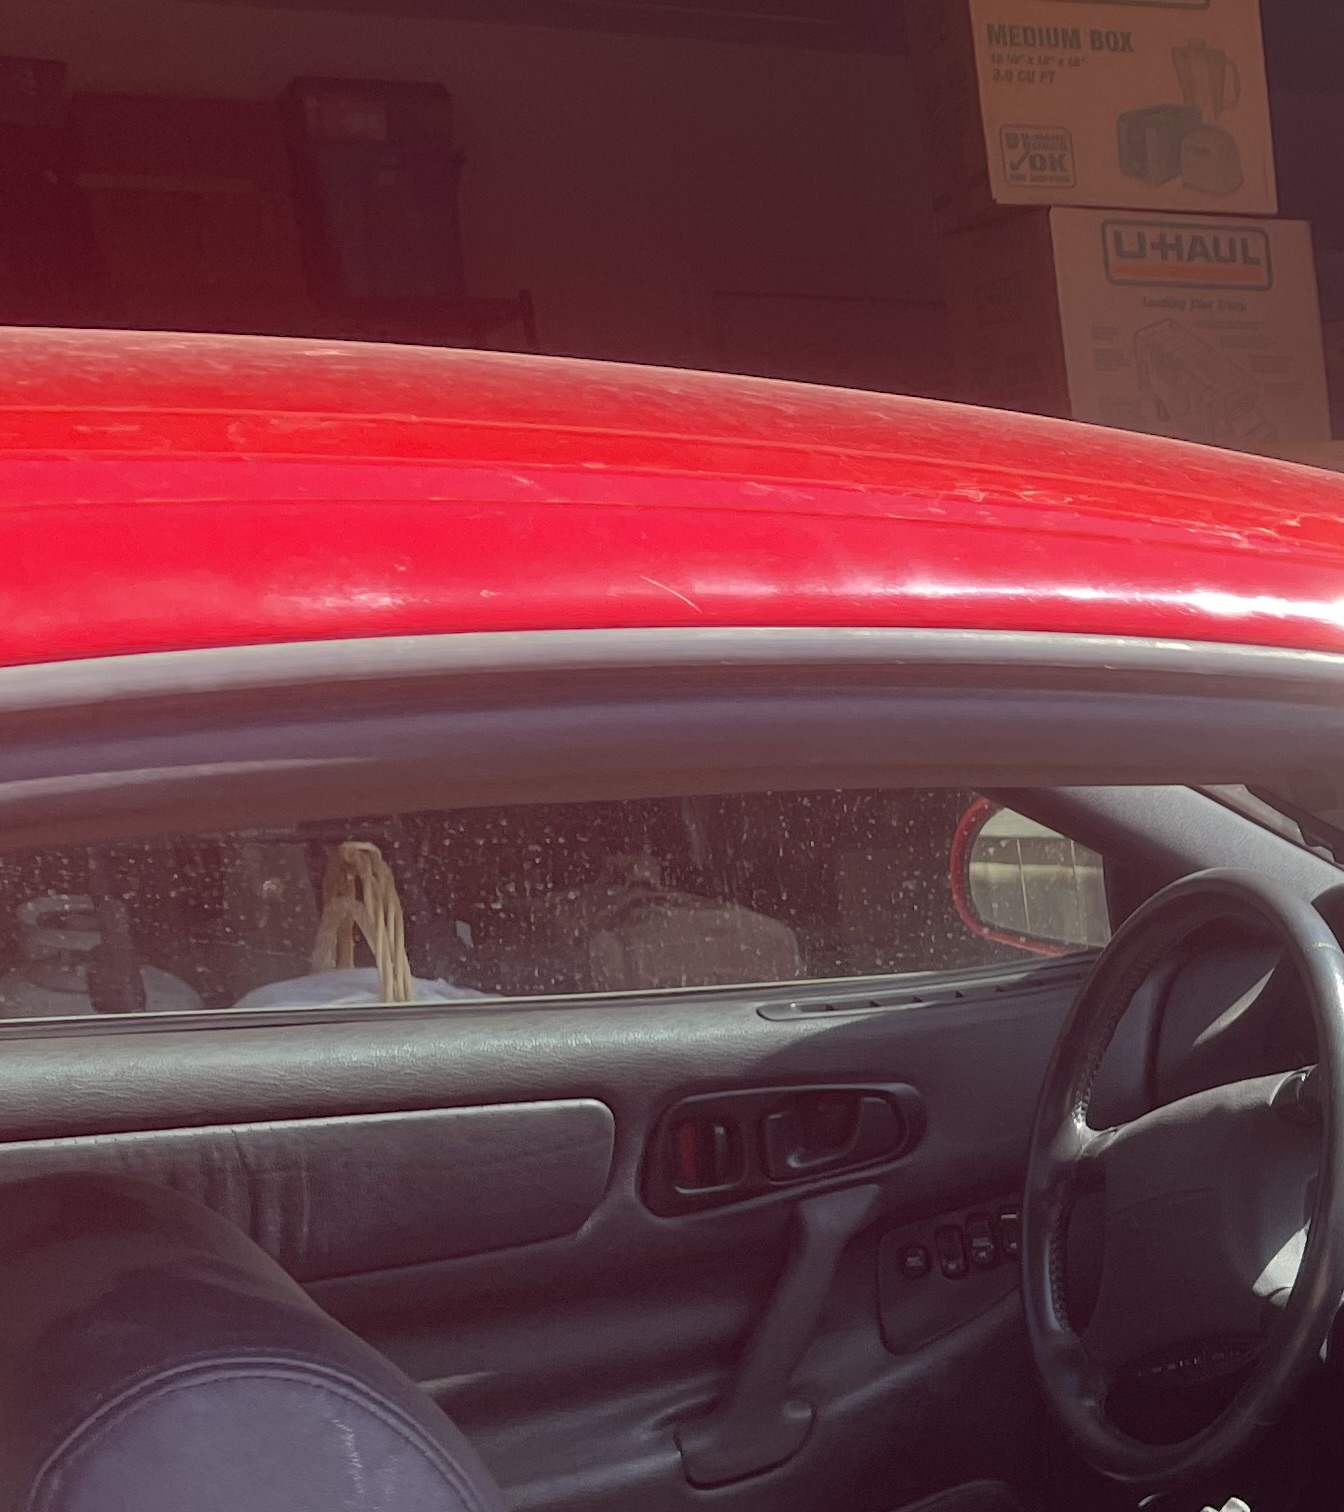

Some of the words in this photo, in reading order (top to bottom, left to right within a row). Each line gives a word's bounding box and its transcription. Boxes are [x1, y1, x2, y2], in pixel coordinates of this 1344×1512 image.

[987, 23, 1082, 50] MEDIUM
[1089, 29, 1134, 53] BOX
[1029, 153, 1069, 172] OK
[1114, 230, 1262, 267] U-HAUL
